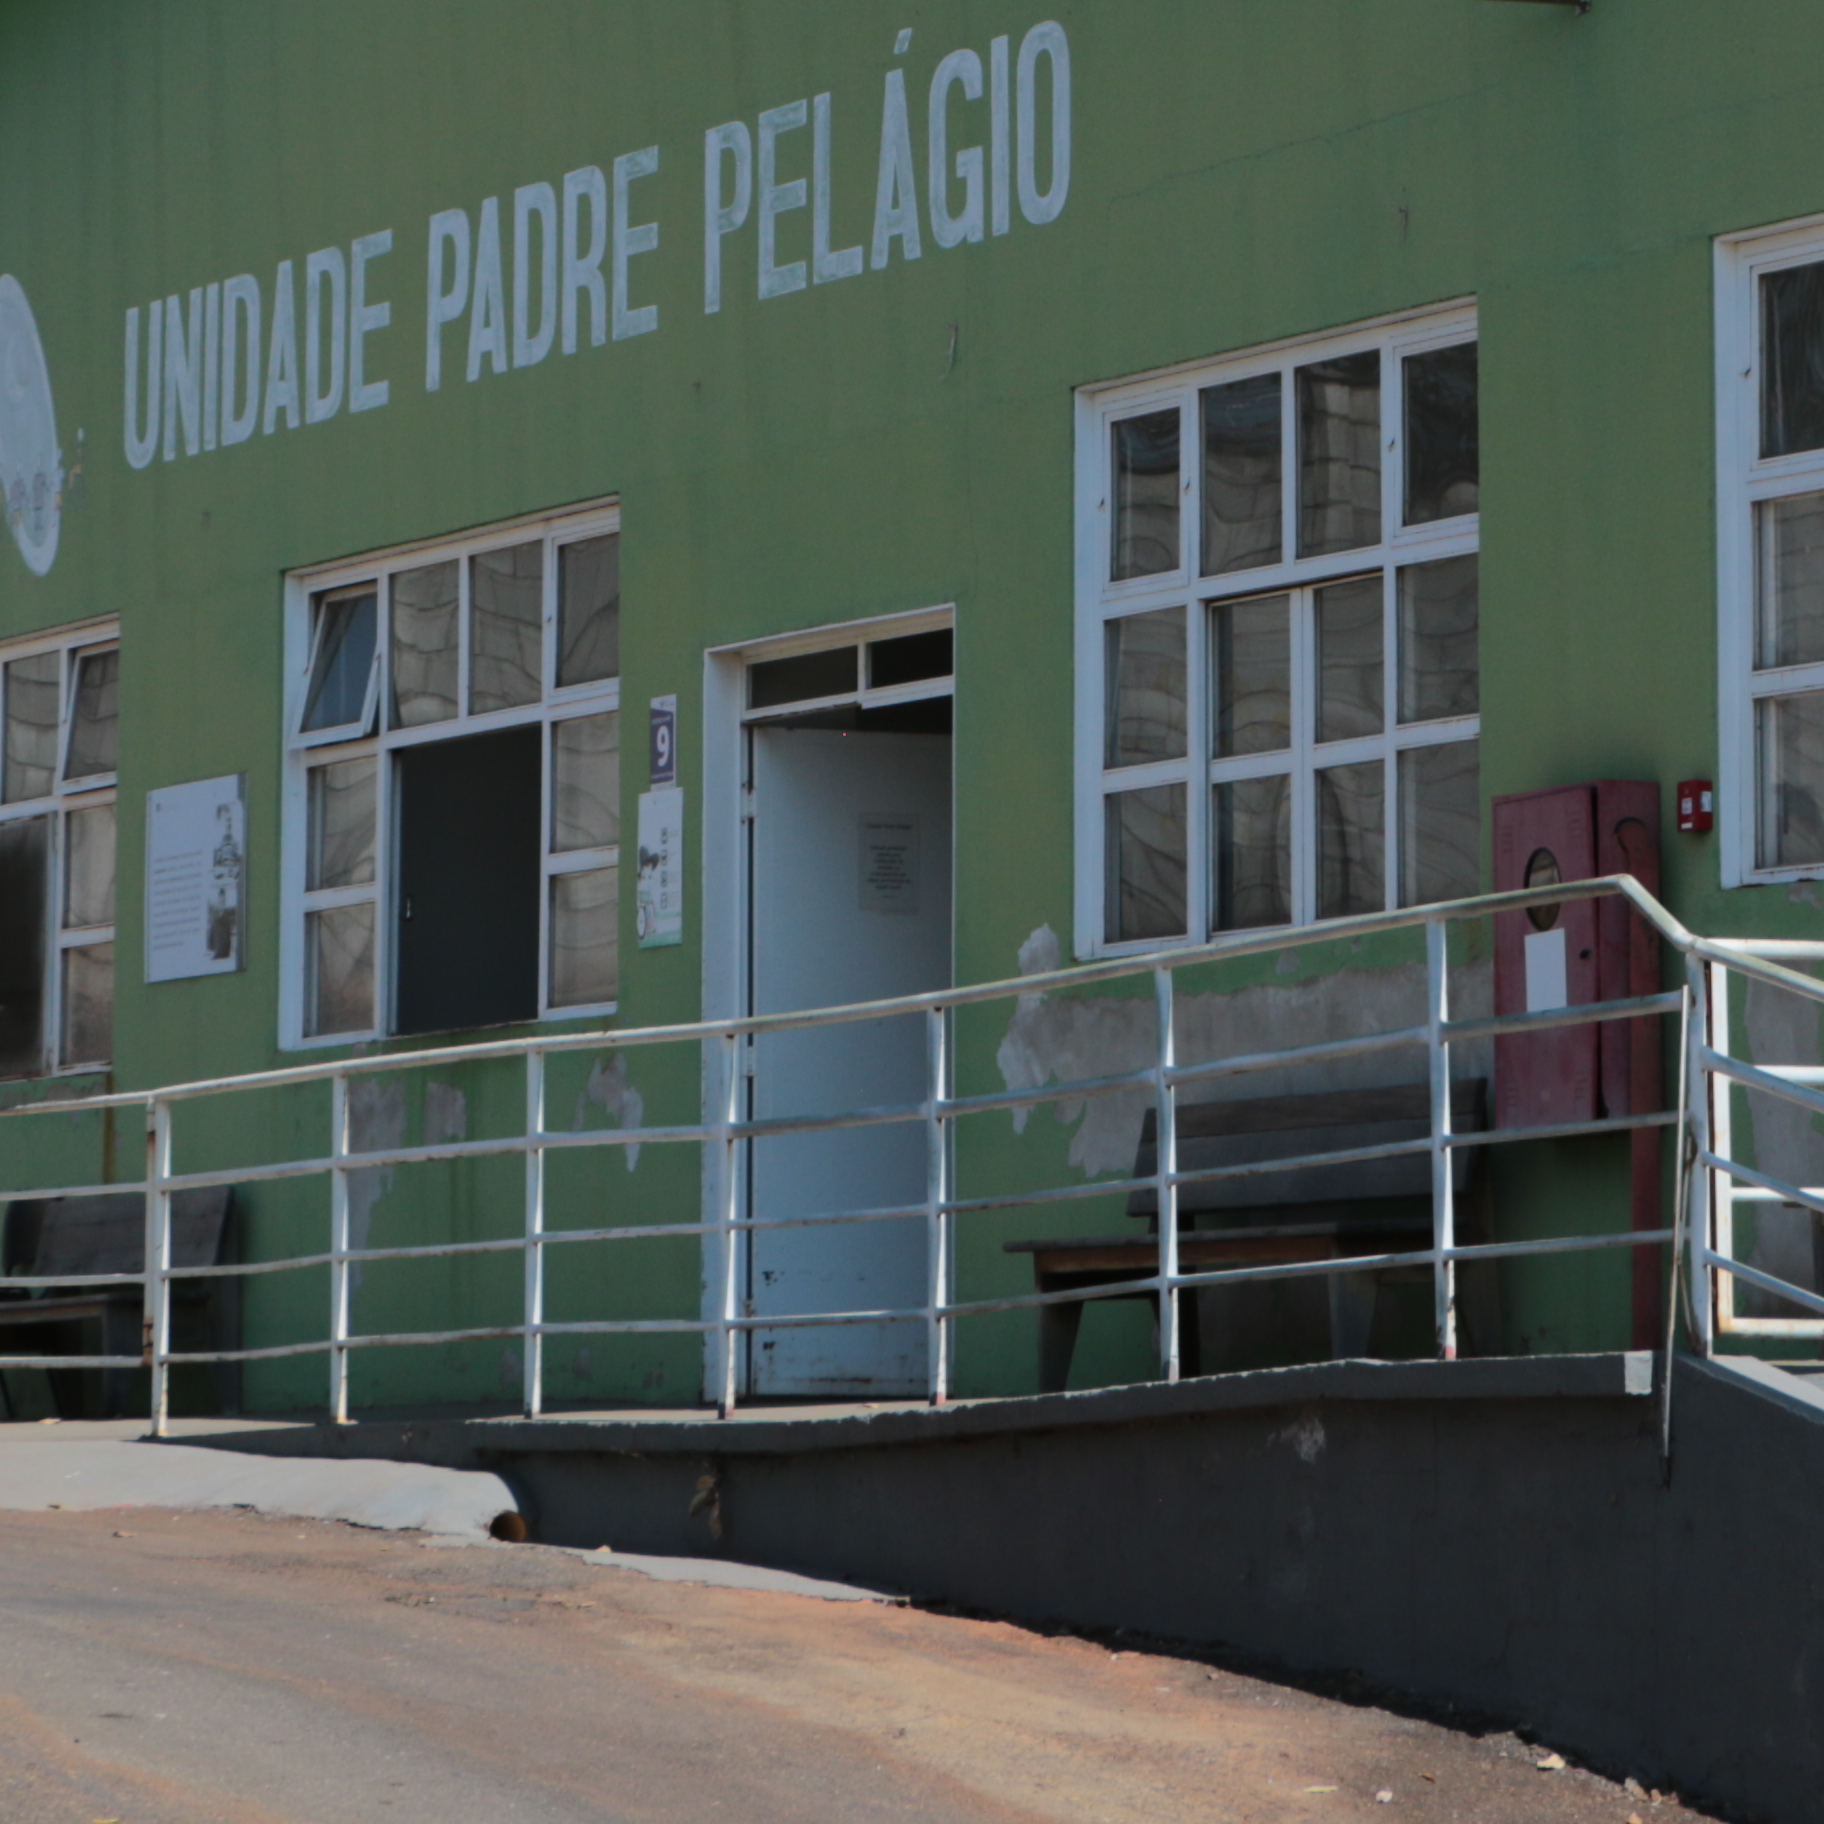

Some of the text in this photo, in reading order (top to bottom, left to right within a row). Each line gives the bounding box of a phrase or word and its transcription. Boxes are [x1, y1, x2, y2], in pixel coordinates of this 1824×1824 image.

[125, 20, 1071, 469] UNIDADE PADRE PELÁGIO
[657, 725, 670, 767] 9
